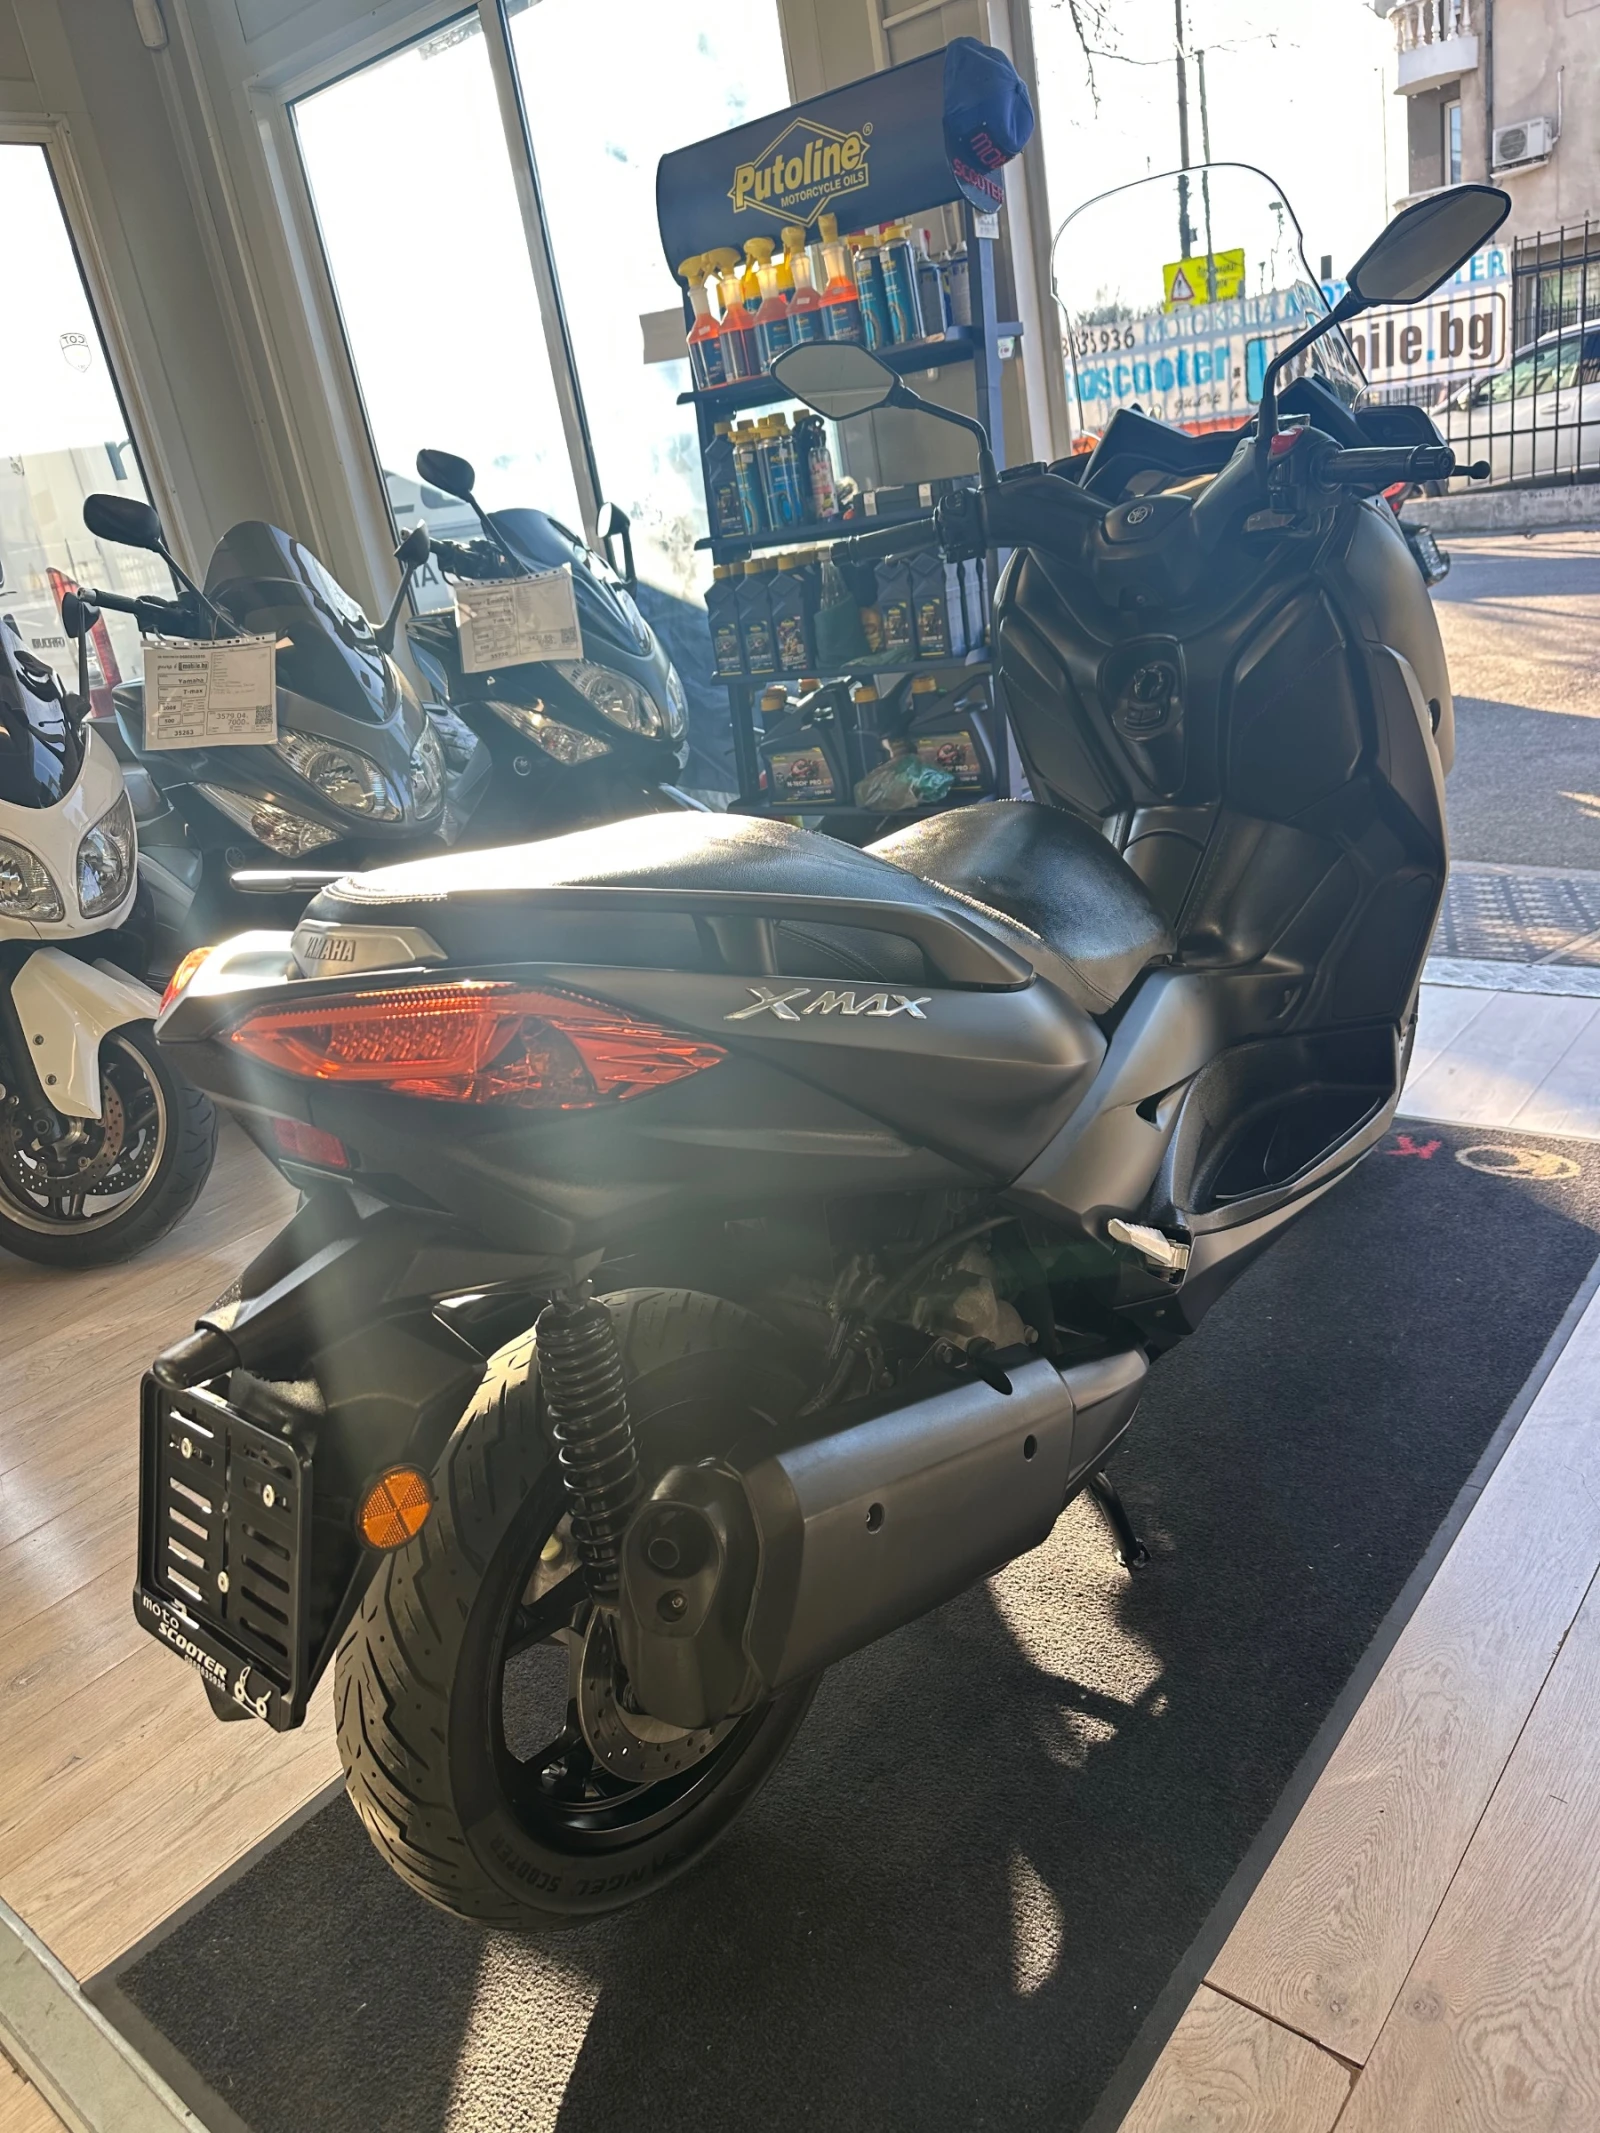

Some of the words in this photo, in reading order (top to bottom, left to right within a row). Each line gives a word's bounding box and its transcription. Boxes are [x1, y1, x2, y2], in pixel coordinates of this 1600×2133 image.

[736, 136, 861, 208] Putoline
[781, 178, 841, 207] MOTORCYCLE
[843, 171, 865, 186] OILS
[304, 936, 356, 962] YAMAHA
[143, 1595, 179, 1629] moto
[158, 1621, 227, 1681] SCOOTER
